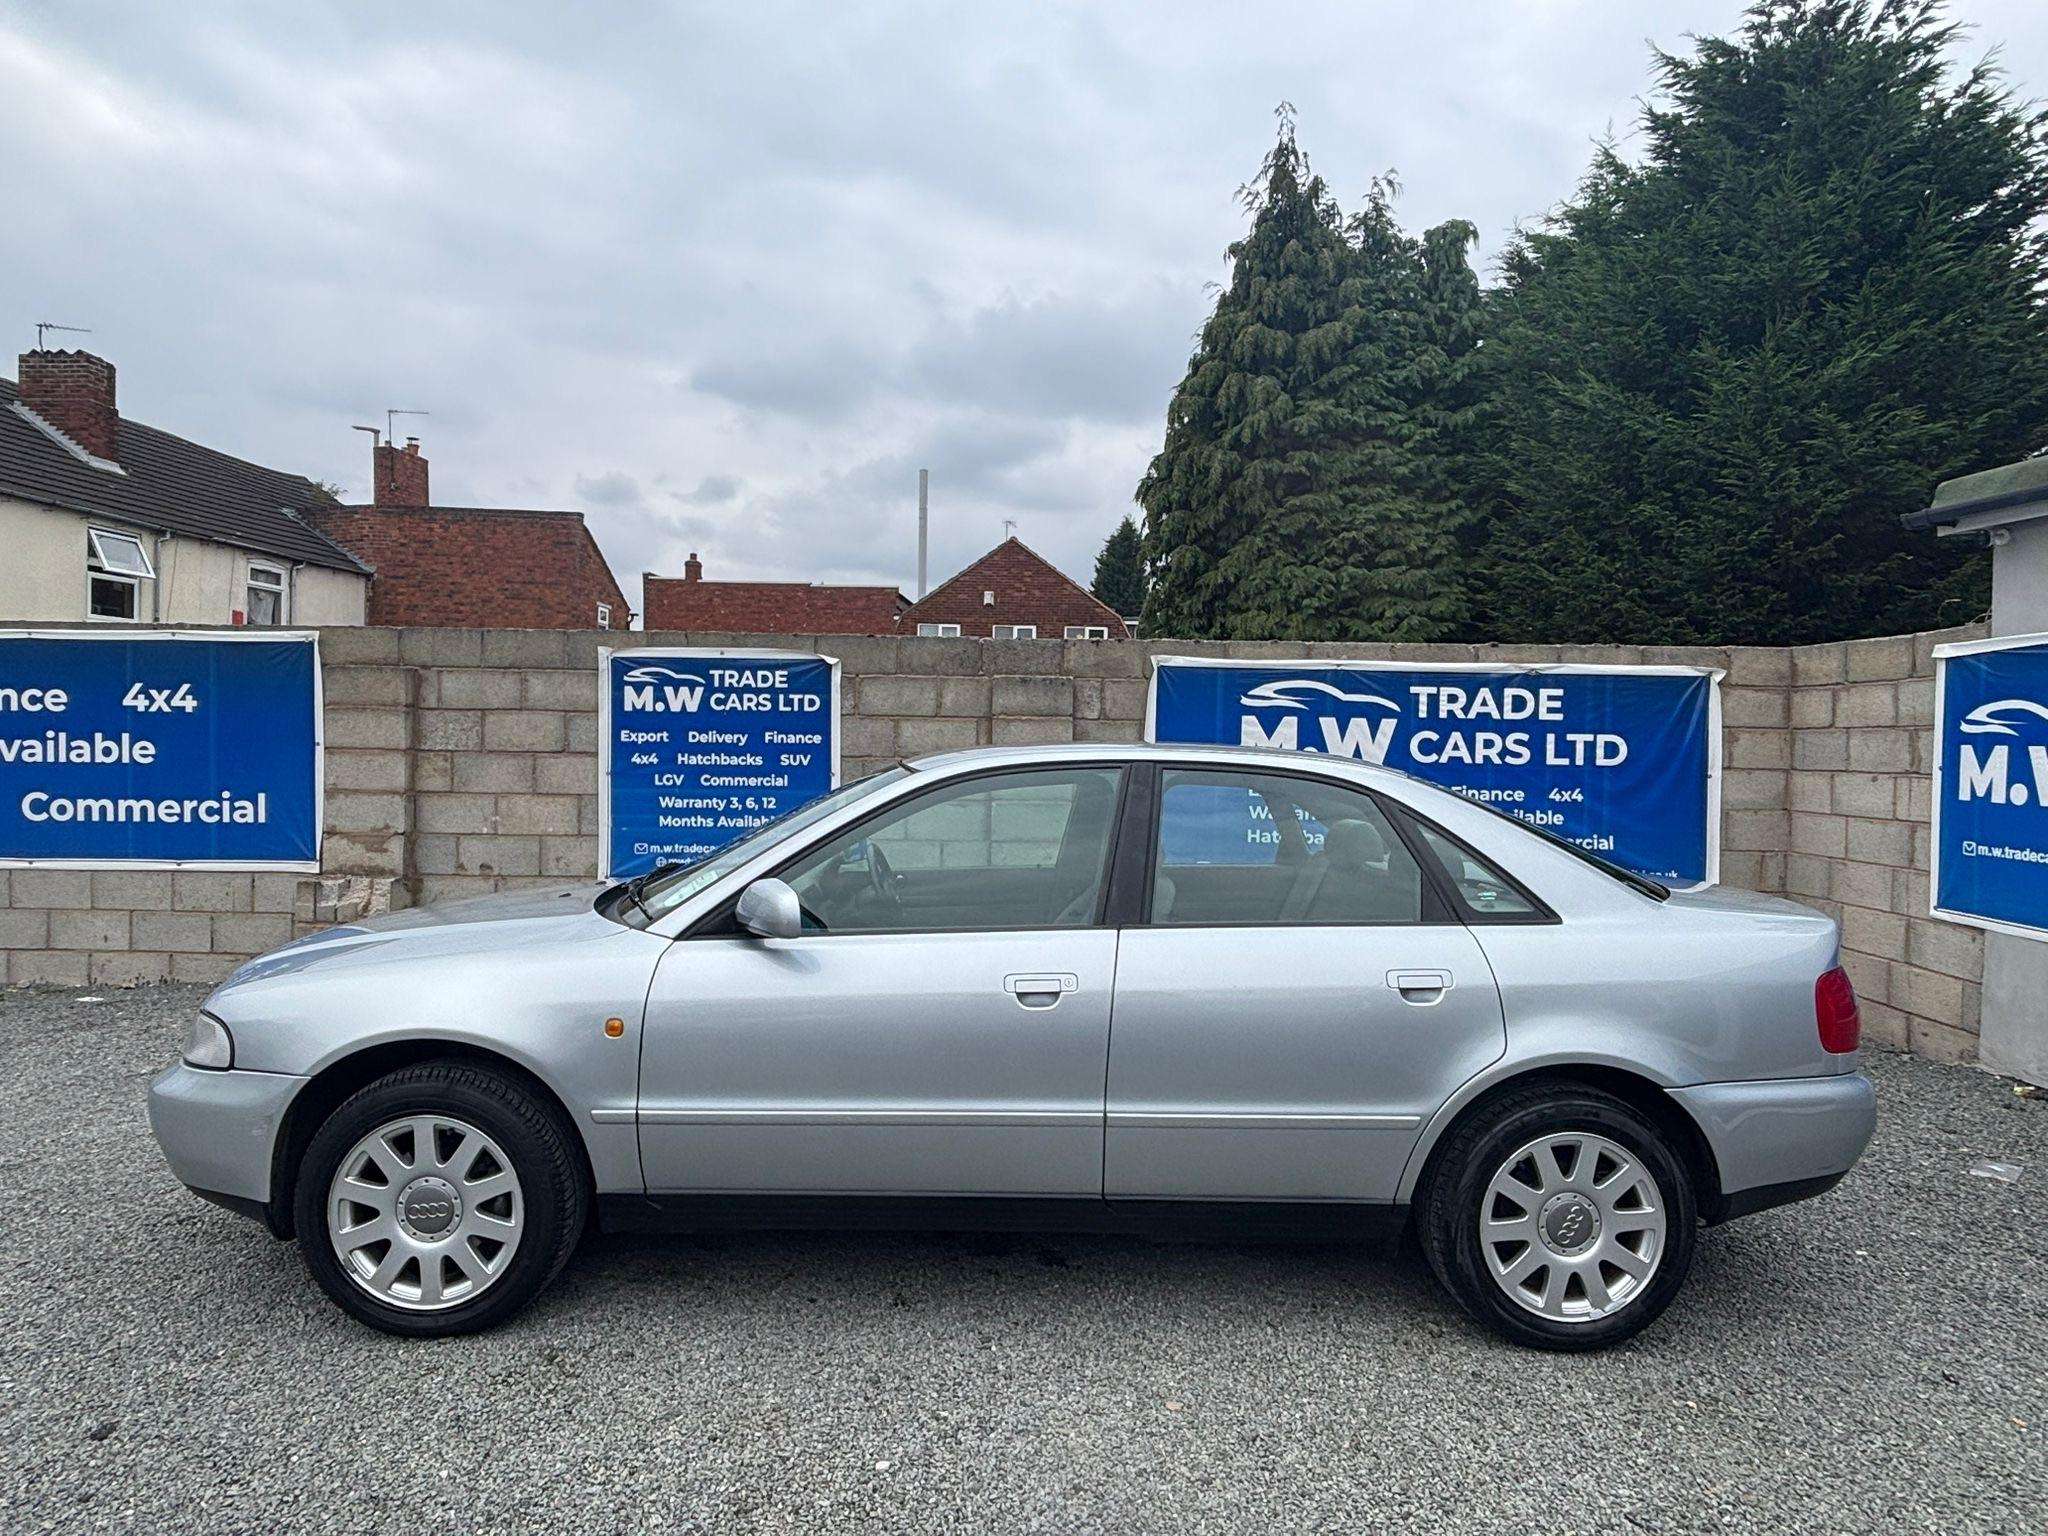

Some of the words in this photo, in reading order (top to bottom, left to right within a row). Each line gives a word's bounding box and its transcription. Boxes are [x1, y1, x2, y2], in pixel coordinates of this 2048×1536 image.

[122, 682, 198, 713] 4x4
[623, 685, 705, 713] M.W
[709, 669, 788, 688] TRADE
[709, 692, 772, 712] CARS
[778, 694, 821, 712] LTD
[1409, 686, 1564, 721] TRADE
[620, 730, 669, 745] Export
[688, 730, 748, 746] Delivery
[764, 731, 822, 744] Finance
[1409, 730, 1531, 766] CARS
[1545, 733, 1628, 767] LTD
[630, 752, 659, 765] 4x4
[677, 752, 763, 766] Hatchbacks
[780, 754, 811, 766] SUV
[654, 773, 684, 786] LGV
[700, 774, 788, 787] Commercial
[659, 796, 727, 811] Warranty
[729, 797, 742, 810] 3,
[745, 797, 759, 810] 6,
[762, 797, 776, 809] 12
[1548, 787, 1584, 802] 4x4
[21, 790, 266, 824] Commercial
[659, 815, 714, 828] Months
